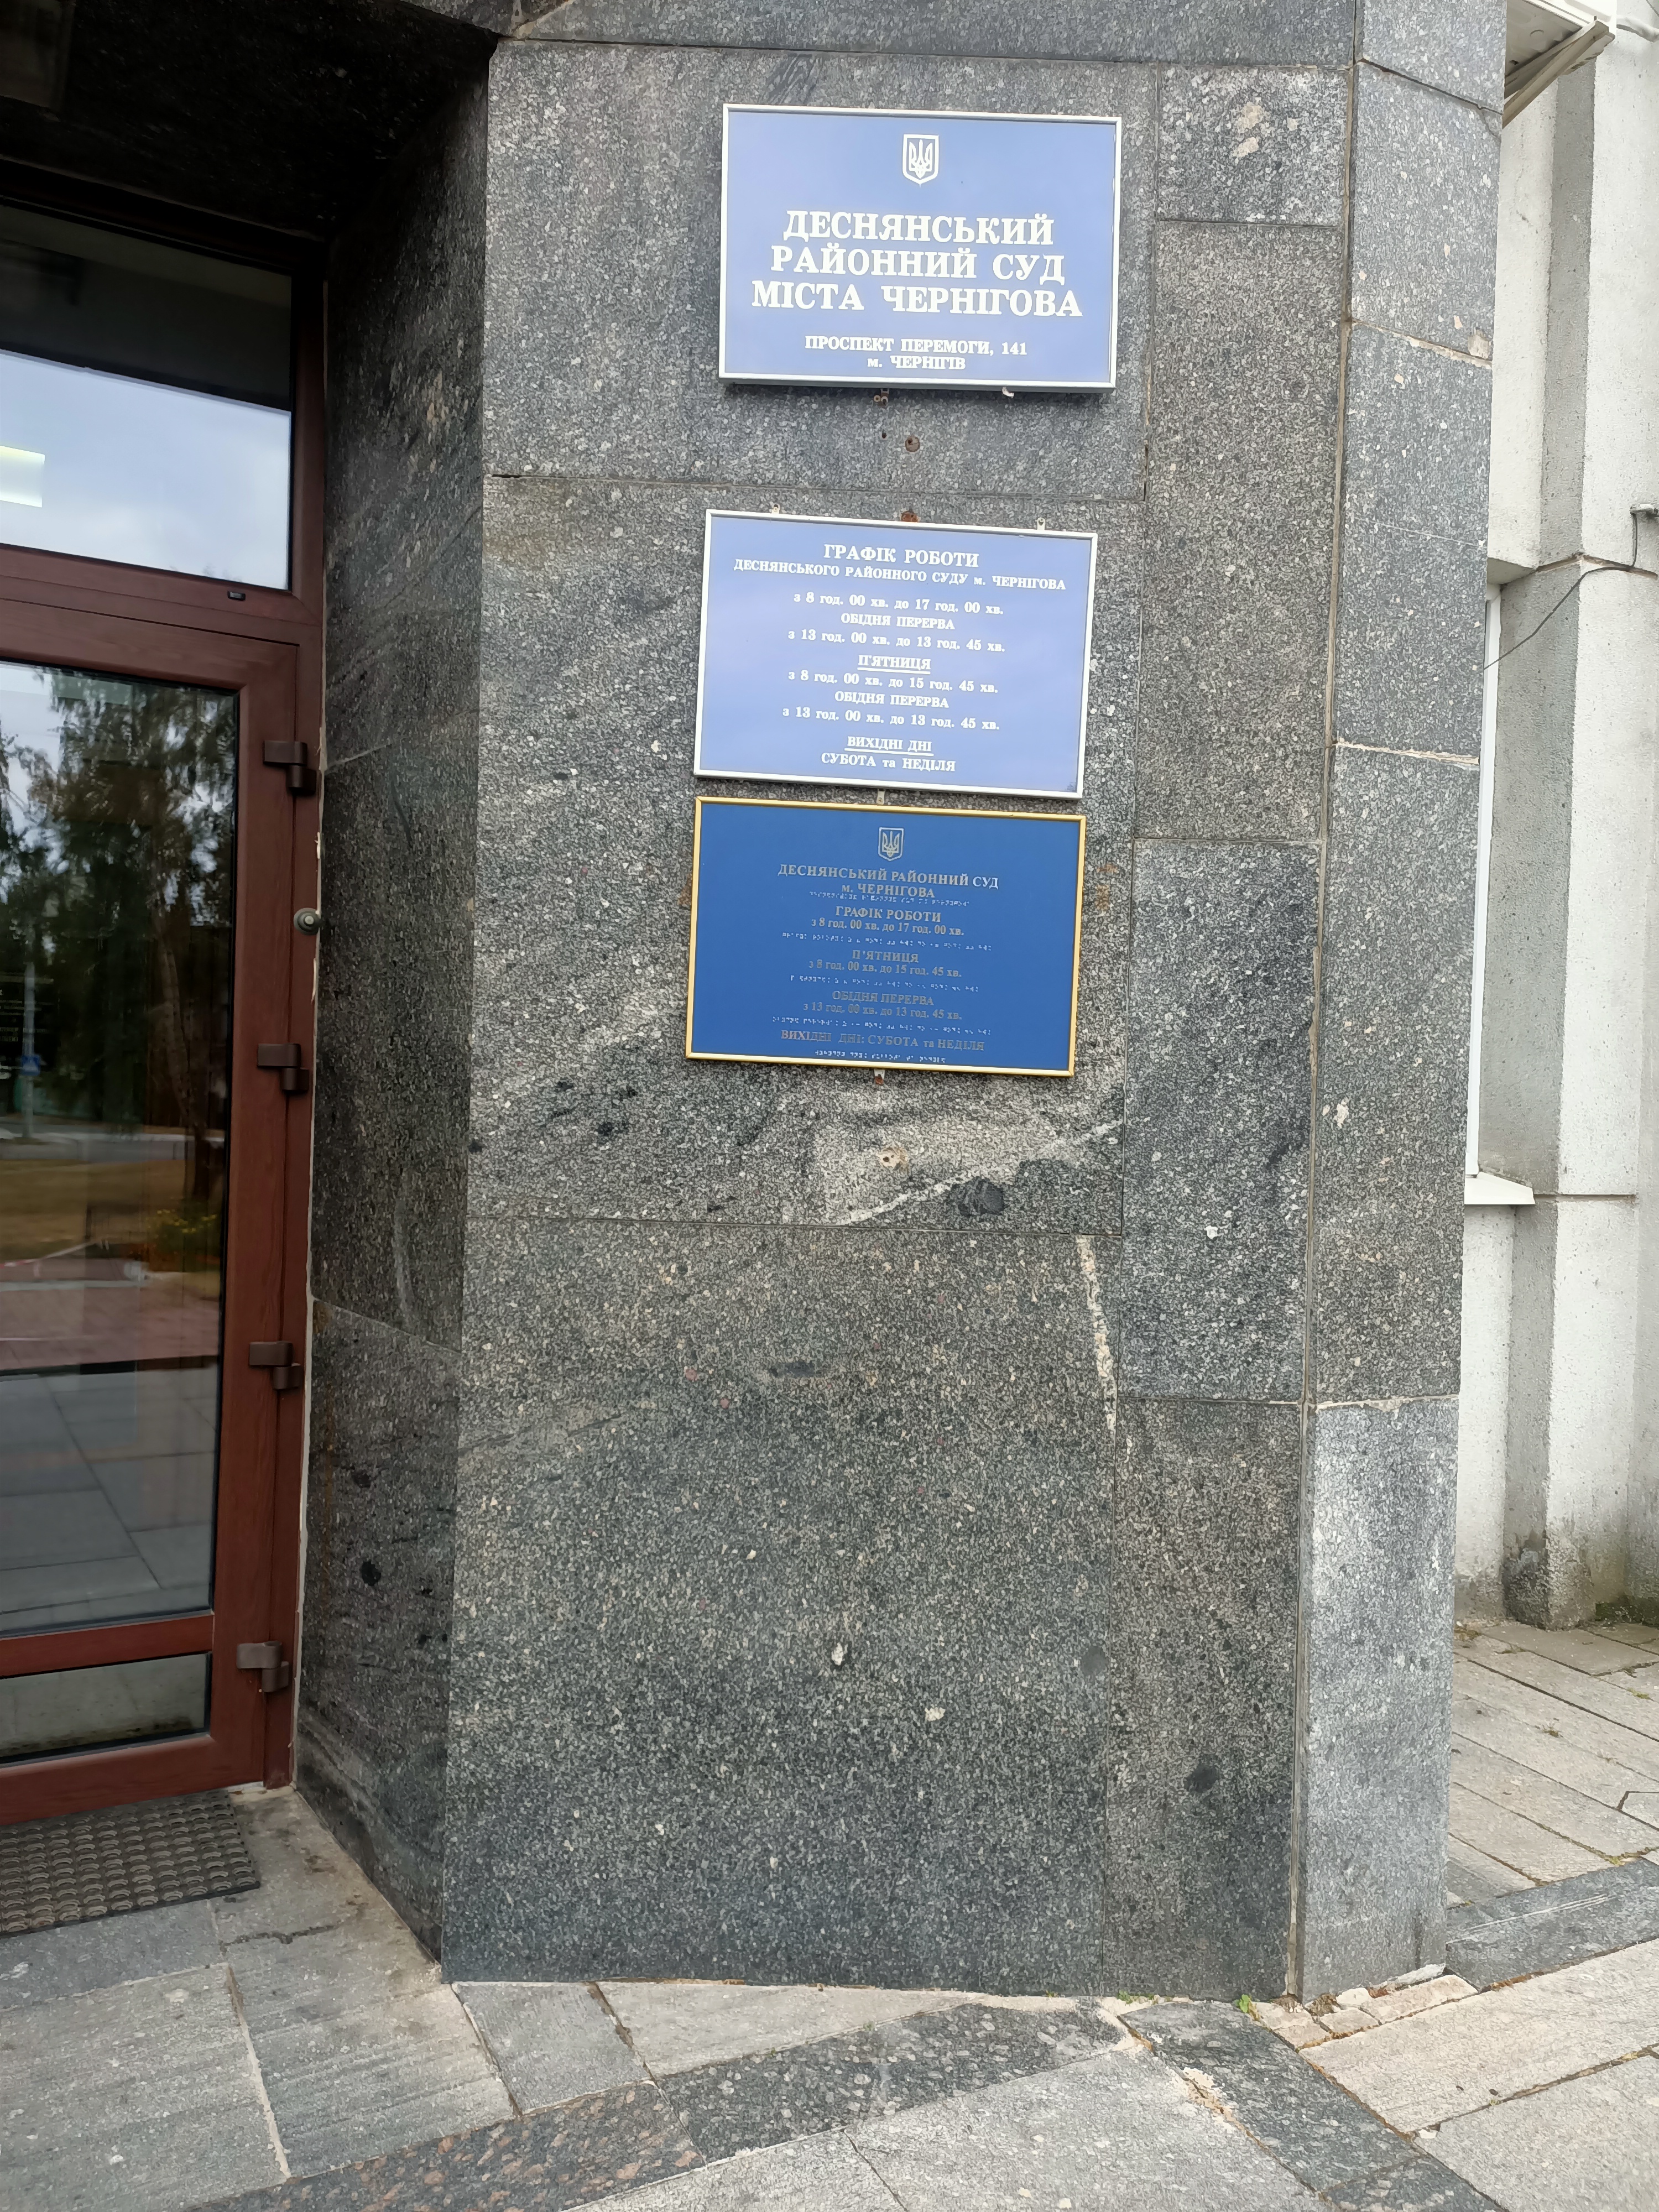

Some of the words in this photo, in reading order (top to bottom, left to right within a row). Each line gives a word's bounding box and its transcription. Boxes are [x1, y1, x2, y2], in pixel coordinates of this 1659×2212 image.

[783, 210, 1055, 245] ДЕСНЯНСЬКИЙ
[770, 242, 977, 278] РАЙОННИЙ
[993, 253, 1065, 286] СУД
[752, 280, 865, 310] МІСТА
[880, 285, 1083, 317] ЧЕРНІГОВА
[805, 336, 894, 352] ПРОСПЕКТ
[900, 338, 994, 356] ПЕРЕМОГИ,
[1001, 342, 1027, 355] 141
[867, 358, 883, 368] м.
[890, 355, 966, 369] ЧЕРНІГІВ
[823, 544, 896, 562] ГРАФІК
[904, 549, 979, 567] РОБОТИ
[733, 559, 840, 576] ДЕСНЯНСЬКОГО
[844, 565, 927, 582] РАЙОННОГО
[932, 572, 969, 586] СУДУ
[973, 577, 986, 586] м.
[992, 575, 1066, 590] ЧЕРНІГОВА
[794, 593, 801, 602] з
[806, 591, 815, 603] 8
[820, 595, 844, 606] год.
[849, 594, 865, 606] 00
[870, 598, 889, 608] хв.
[894, 600, 909, 609] до
[915, 598, 930, 611] 17
[935, 601, 958, 613] год.
[964, 601, 980, 613] 00
[985, 606, 1004, 615] хв.
[841, 613, 891, 627] ОБІДНЯ
[896, 616, 955, 630] ПЕРЕРВА
[788, 630, 795, 639] з
[801, 629, 816, 640] 13
[821, 633, 845, 643] год.
[851, 632, 867, 644] 00
[872, 636, 890, 645] хв.
[895, 638, 911, 647] до
[917, 636, 931, 648] 13
[936, 640, 961, 650] год.
[966, 639, 982, 650] 45
[987, 643, 1005, 652] хв.
[788, 671, 795, 680] з
[800, 669, 809, 681] 8
[814, 674, 838, 684] год.
[843, 672, 860, 685] 00
[864, 677, 883, 686] хв.
[888, 679, 903, 688] до
[909, 677, 924, 688] 15
[929, 681, 953, 691] год.
[958, 680, 974, 692] 45
[980, 684, 998, 693] хв.
[834, 691, 885, 705] ОБІДНЯ
[890, 695, 950, 708] ПЕРЕРВА
[782, 708, 790, 717] з
[796, 706, 811, 718] 13
[816, 711, 839, 721] год.
[844, 709, 861, 722] 00
[865, 714, 884, 723] хв.
[889, 716, 905, 725] до
[910, 714, 926, 726] 13
[931, 718, 955, 728] год.
[961, 717, 976, 729] 45
[981, 721, 1000, 730] хв.
[847, 736, 903, 750] ВИХІДНІ
[907, 740, 932, 753] ДНІ
[821, 752, 877, 766] СУБОТА
[882, 759, 896, 768] та
[902, 758, 956, 772] НЕДІЛЯ
[777, 864, 888, 881] ДЕСНЯНСЬКИЙ
[891, 869, 969, 886] РАЙОННИЙ
[972, 876, 999, 890] СУД
[841, 884, 854, 893] м.
[858, 883, 936, 899] ЧЕРНІГОВА
[835, 906, 883, 919] ГРАФІК
[885, 909, 941, 922] РОБОТИ
[818, 917, 825, 927] 8
[827, 920, 847, 929] год.
[849, 919, 862, 930] 00
[864, 922, 880, 931] хв.
[881, 924, 895, 932] до
[898, 922, 910, 932] 17
[912, 925, 931, 935] год.
[934, 924, 947, 935] 00
[948, 927, 964, 936] хв.
[816, 959, 823, 969] 8
[825, 962, 845, 971] год.
[847, 961, 860, 971] 00
[862, 964, 877, 972] хв.
[879, 965, 893, 974] до
[895, 964, 907, 974] 15
[909, 967, 929, 975] год.
[931, 966, 944, 976] 45
[946, 969, 962, 978] хв.
[832, 990, 878, 1003] ОБІДНЯ
[880, 993, 934, 1005] ПЕРЕРВА
[811, 1001, 823, 1011] 13
[826, 1004, 845, 1014] год.
[848, 1003, 860, 1014] 00
[896, 1006, 907, 1016] 13
[910, 1010, 930, 1019] год.
[932, 1009, 945, 1019] 45
[780, 1029, 832, 1042] ВИХІДНІ
[838, 1033, 864, 1044] ДНІ:
[867, 1035, 919, 1047] СУБОТА
[937, 1039, 985, 1051] НЕДІЛЯ
